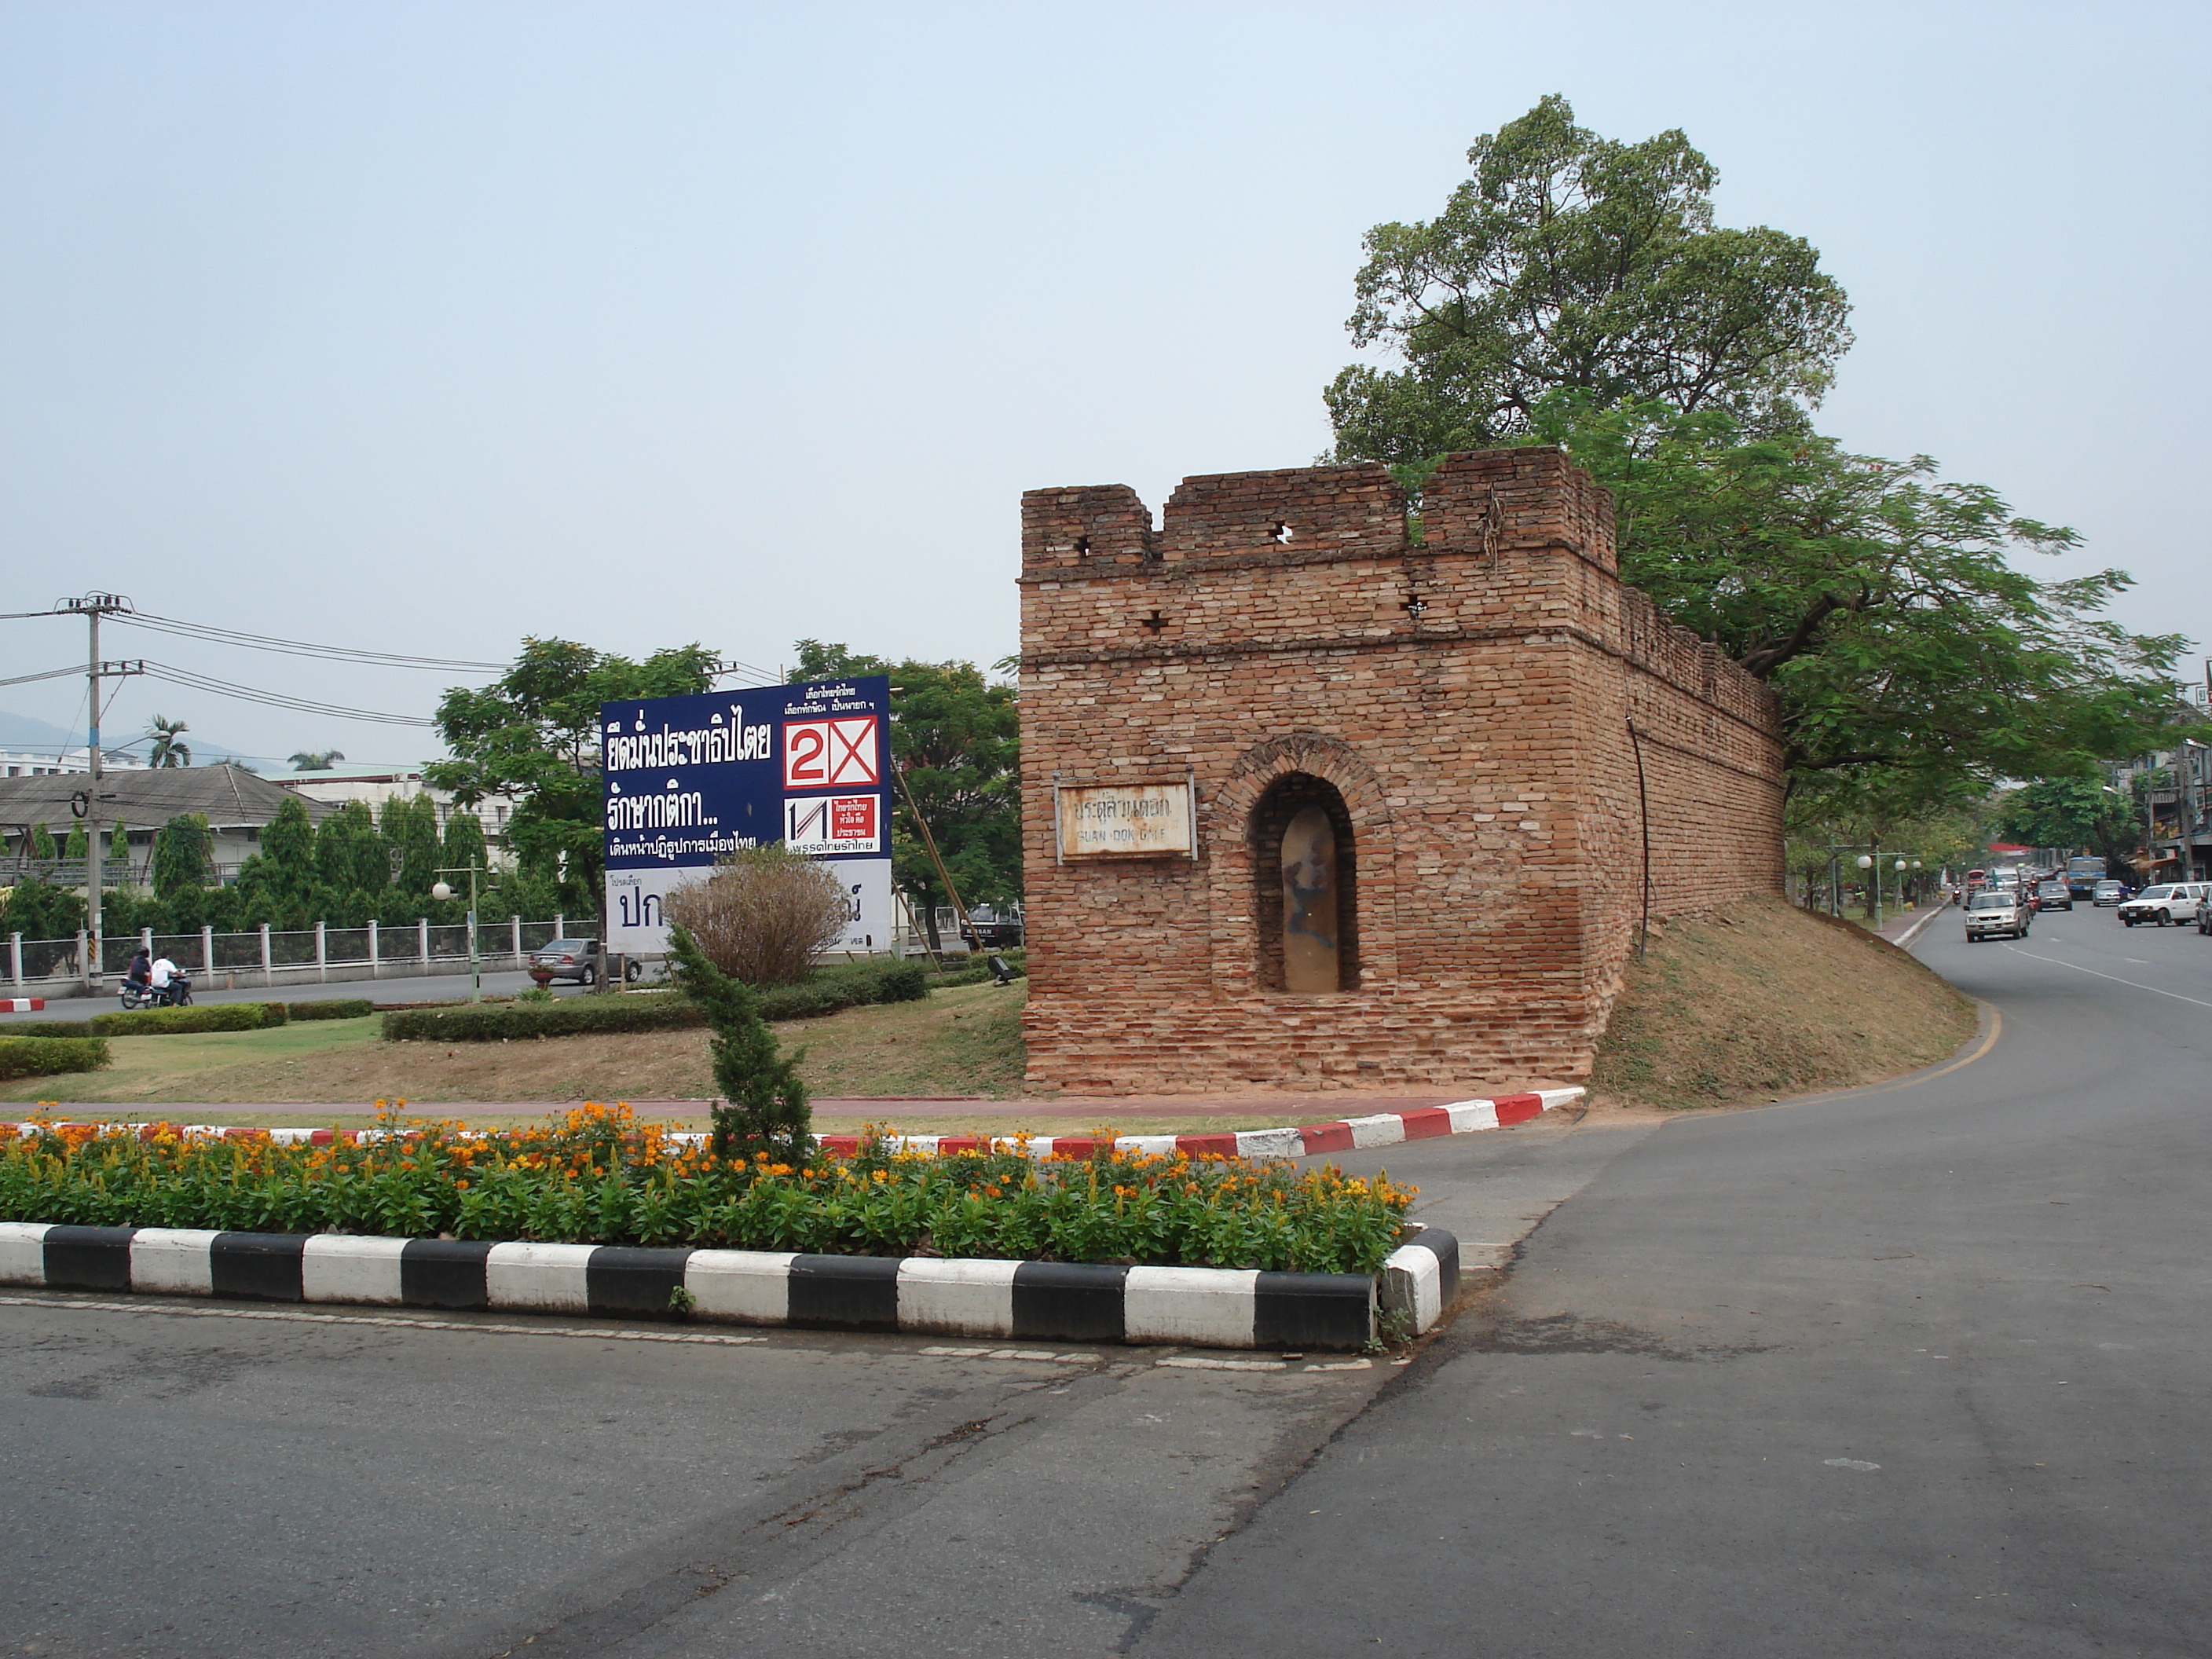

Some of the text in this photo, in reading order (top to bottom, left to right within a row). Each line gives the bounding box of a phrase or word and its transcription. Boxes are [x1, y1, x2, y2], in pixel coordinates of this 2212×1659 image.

[607, 704, 771, 771] ยึดมั่นประชาธิปไตย
[790, 728, 824, 780] 2
[793, 839, 873, 852] พรรคไทยรักไทย
[1113, 828, 1134, 841] DOK
[620, 886, 663, 927] ปก
